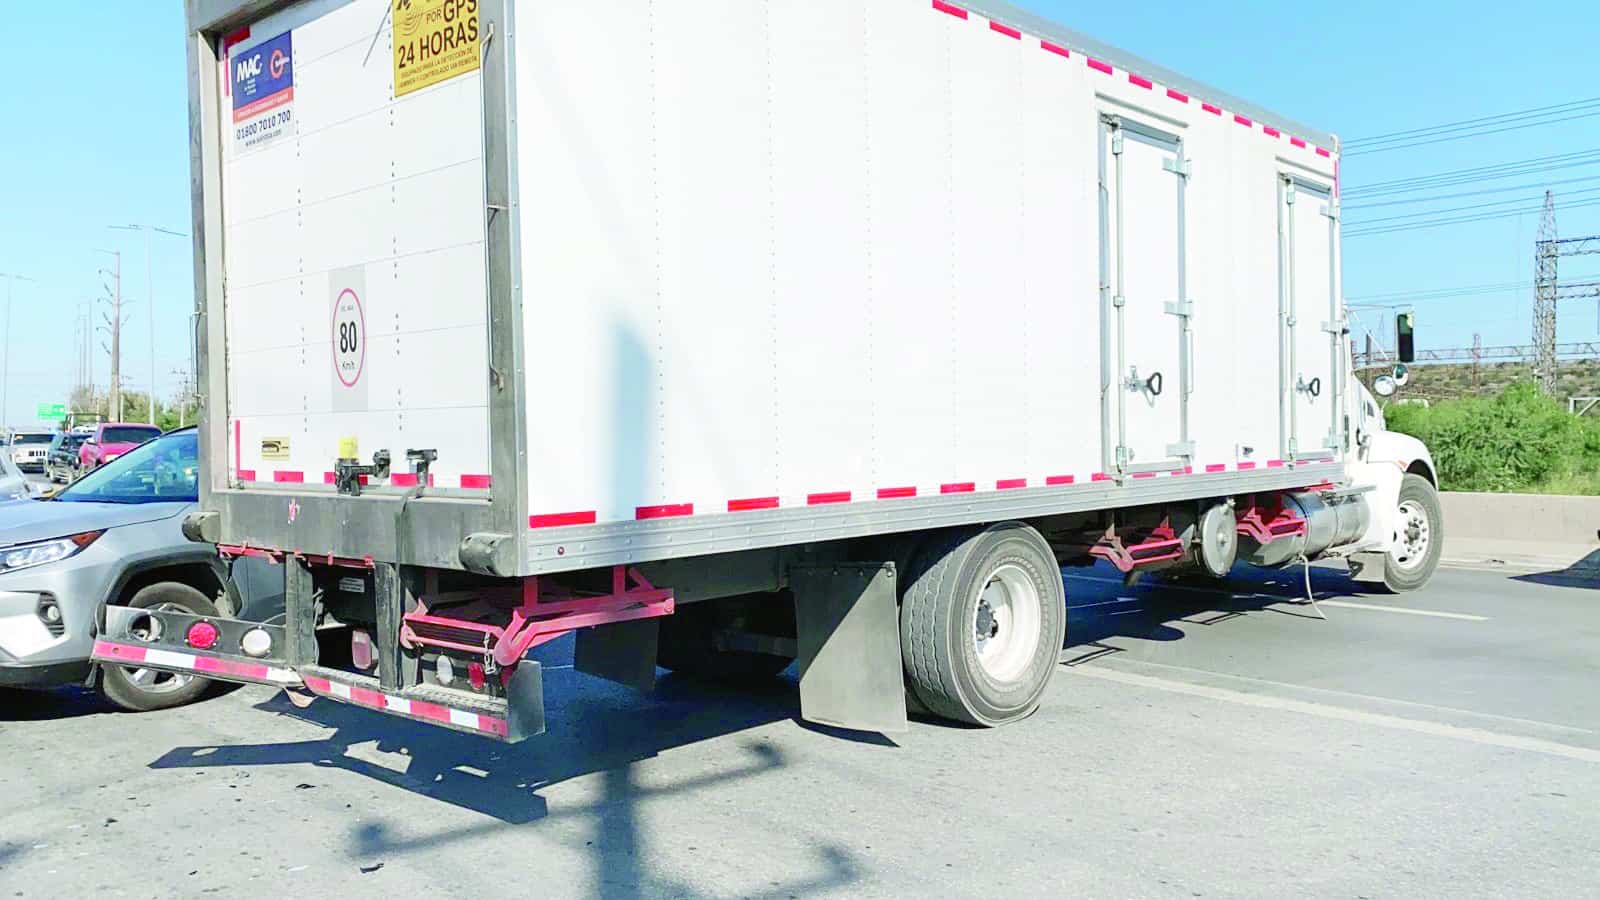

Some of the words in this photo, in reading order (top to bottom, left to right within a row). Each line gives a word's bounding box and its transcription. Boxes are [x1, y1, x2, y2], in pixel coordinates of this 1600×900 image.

[426, 9, 441, 24] POR
[443, 0, 477, 23] GPS
[398, 41, 415, 69] 24
[420, 16, 478, 61] HORAS
[237, 54, 263, 83] MAC
[236, 122, 257, 140] 01800
[259, 115, 276, 132] 7010
[278, 109, 291, 124] 700
[340, 321, 357, 353] 80
